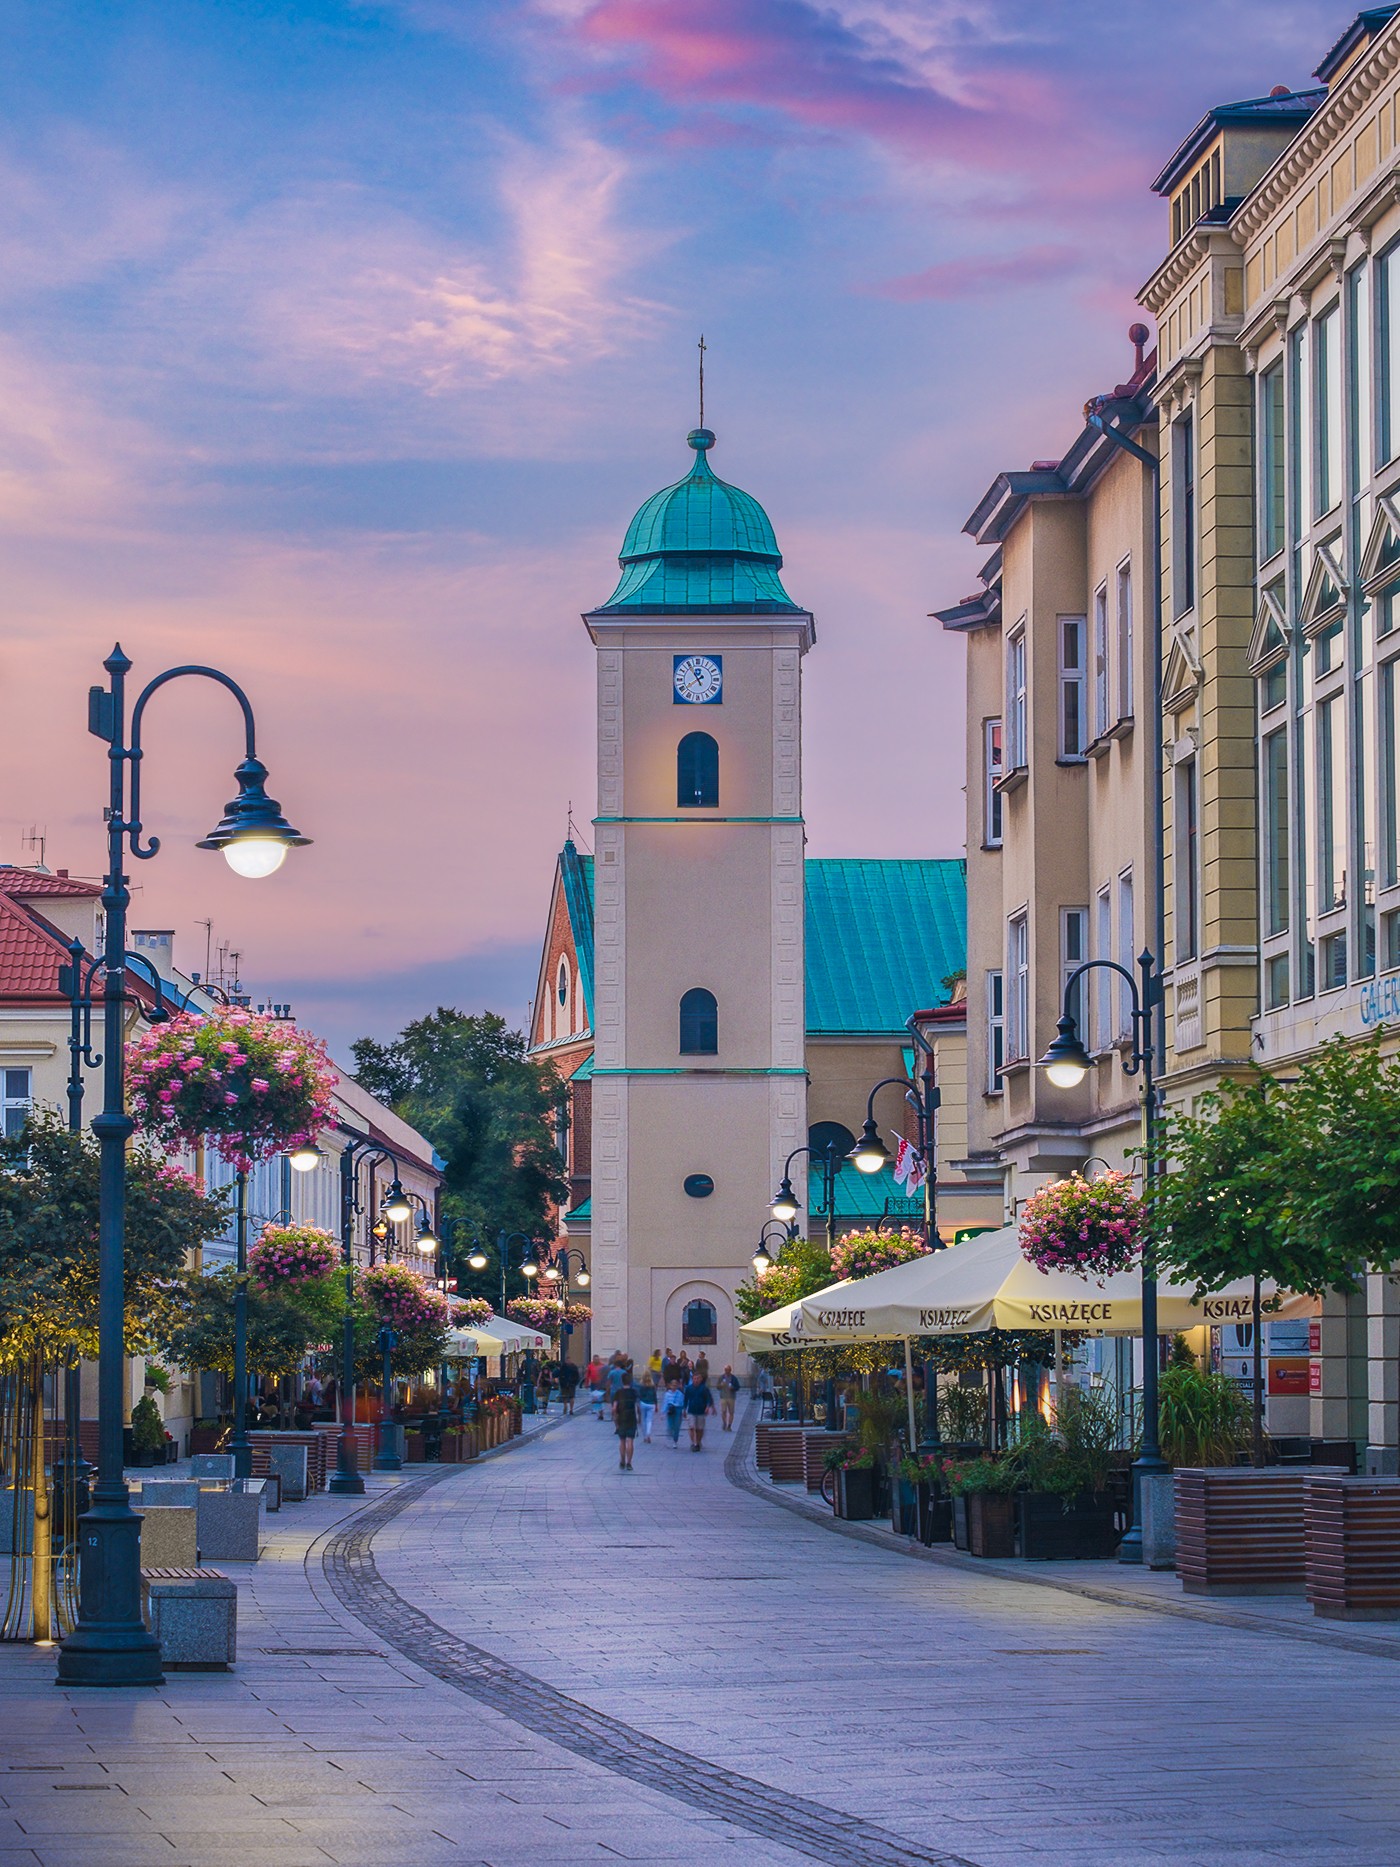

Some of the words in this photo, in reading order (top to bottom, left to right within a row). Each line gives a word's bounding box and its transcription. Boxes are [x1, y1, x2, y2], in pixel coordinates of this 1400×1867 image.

[818, 1307, 866, 1330] KSIĄŻĘCE
[1029, 1299, 1112, 1325] KSIĄŻĘCE
[88, 1537, 97, 1546] 12
